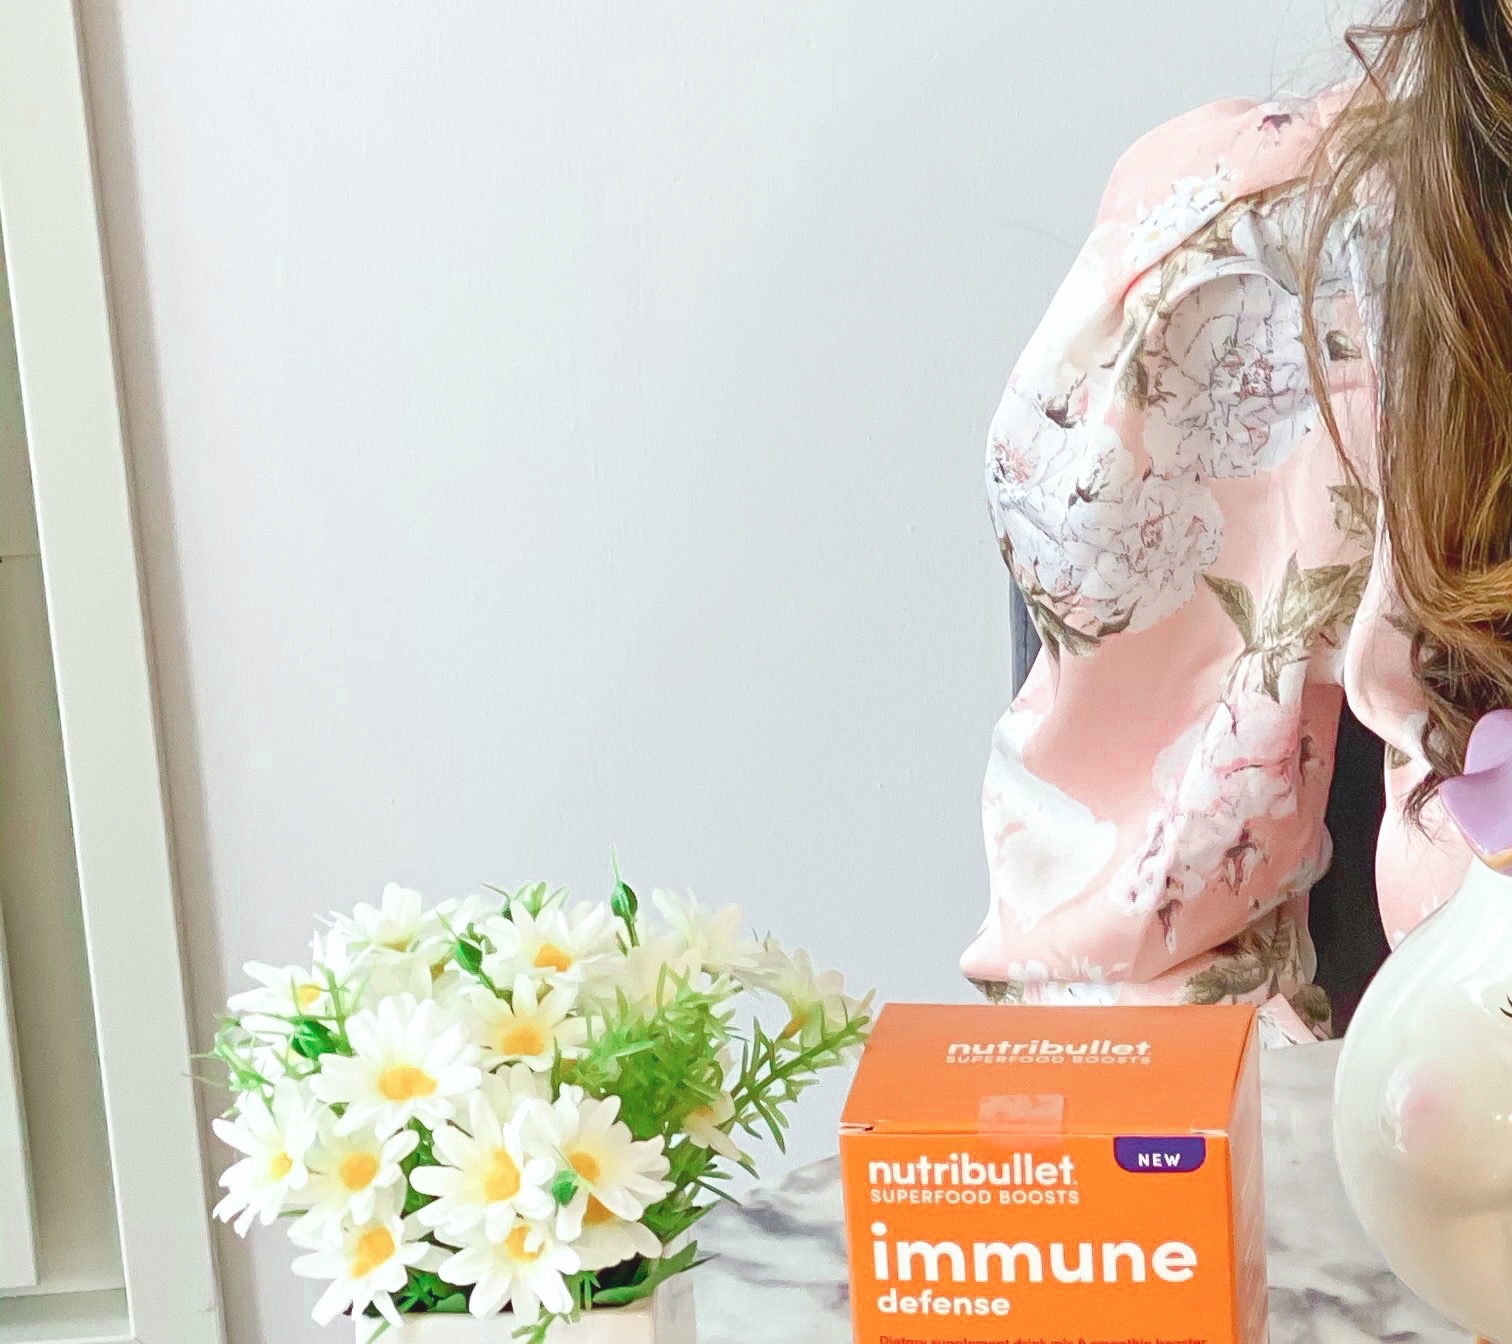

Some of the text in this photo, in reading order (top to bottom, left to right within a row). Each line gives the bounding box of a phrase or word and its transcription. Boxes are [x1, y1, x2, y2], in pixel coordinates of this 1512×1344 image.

[947, 1040, 1152, 1056] nutribullet
[945, 1056, 1152, 1065] SUPERFOOD BOOSTS
[1137, 1152, 1181, 1167] NEW
[868, 1153, 1076, 1186] nutribullet
[870, 1188, 1080, 1205] SUPERFOOD BOOSTS
[870, 1221, 1198, 1283] immune
[877, 1287, 1011, 1316] defense
